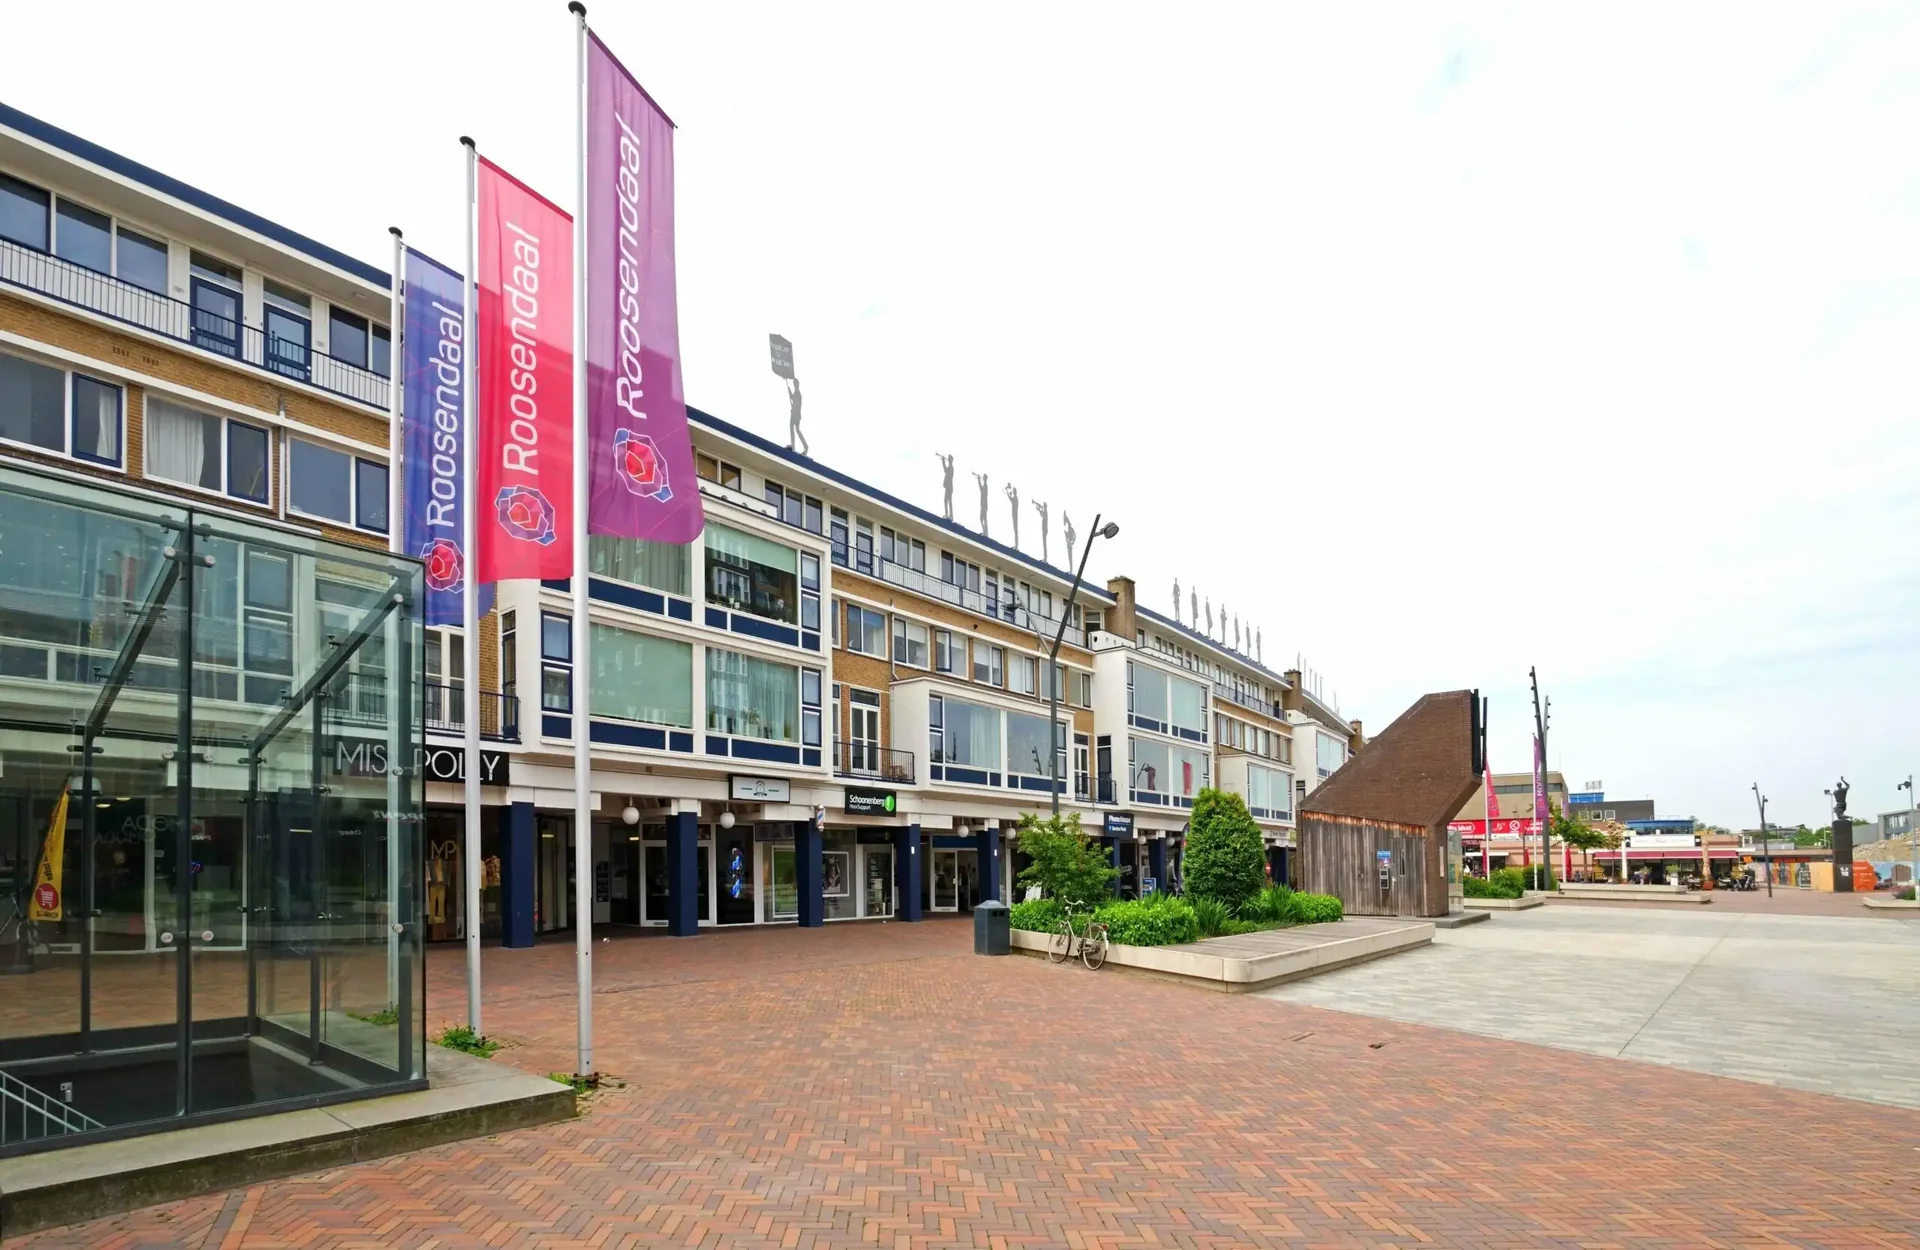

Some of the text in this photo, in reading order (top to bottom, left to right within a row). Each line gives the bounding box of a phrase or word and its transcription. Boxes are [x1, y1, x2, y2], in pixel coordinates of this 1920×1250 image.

[615, 111, 647, 420] Roosendaal
[503, 220, 540, 475] Roosendaal
[426, 301, 463, 527] Roosendaal
[336, 740, 388, 774] MIS
[849, 795, 885, 807] Schoonenberg
[431, 839, 457, 860] MP
